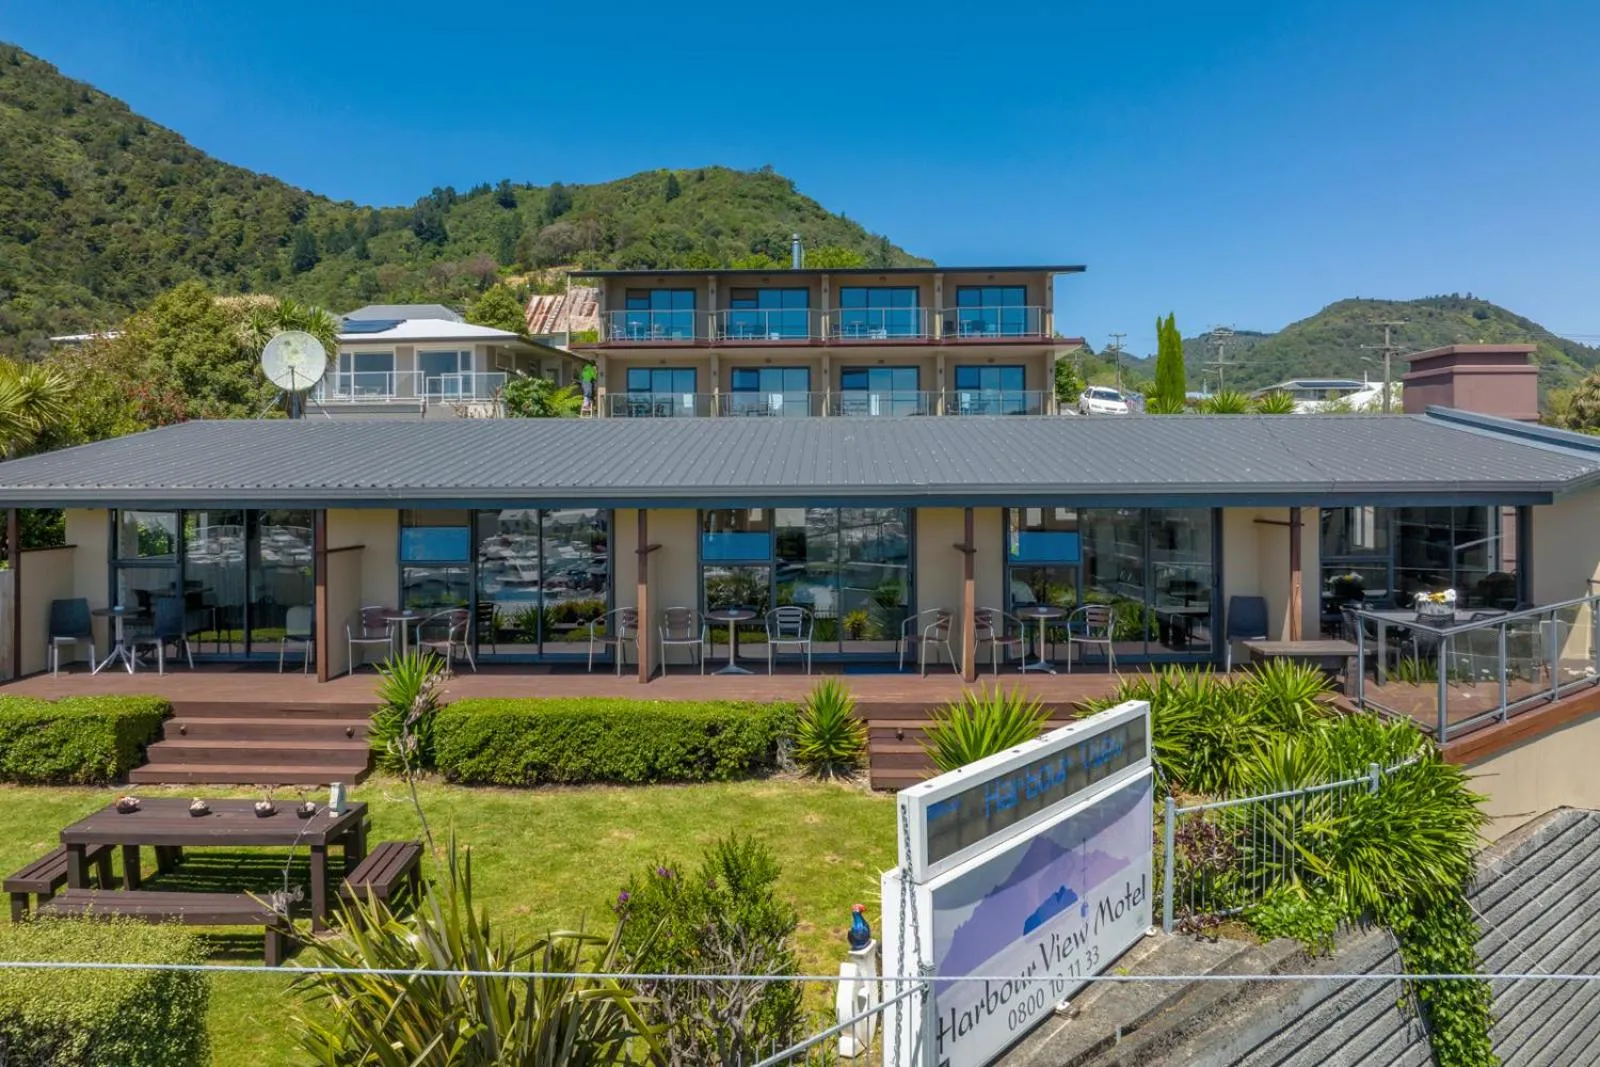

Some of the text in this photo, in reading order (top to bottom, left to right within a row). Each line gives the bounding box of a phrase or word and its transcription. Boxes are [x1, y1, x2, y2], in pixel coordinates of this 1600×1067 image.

[936, 873, 1146, 1055] Harbour View Motel
[1008, 945, 1100, 1032] 0800 10 11 33
